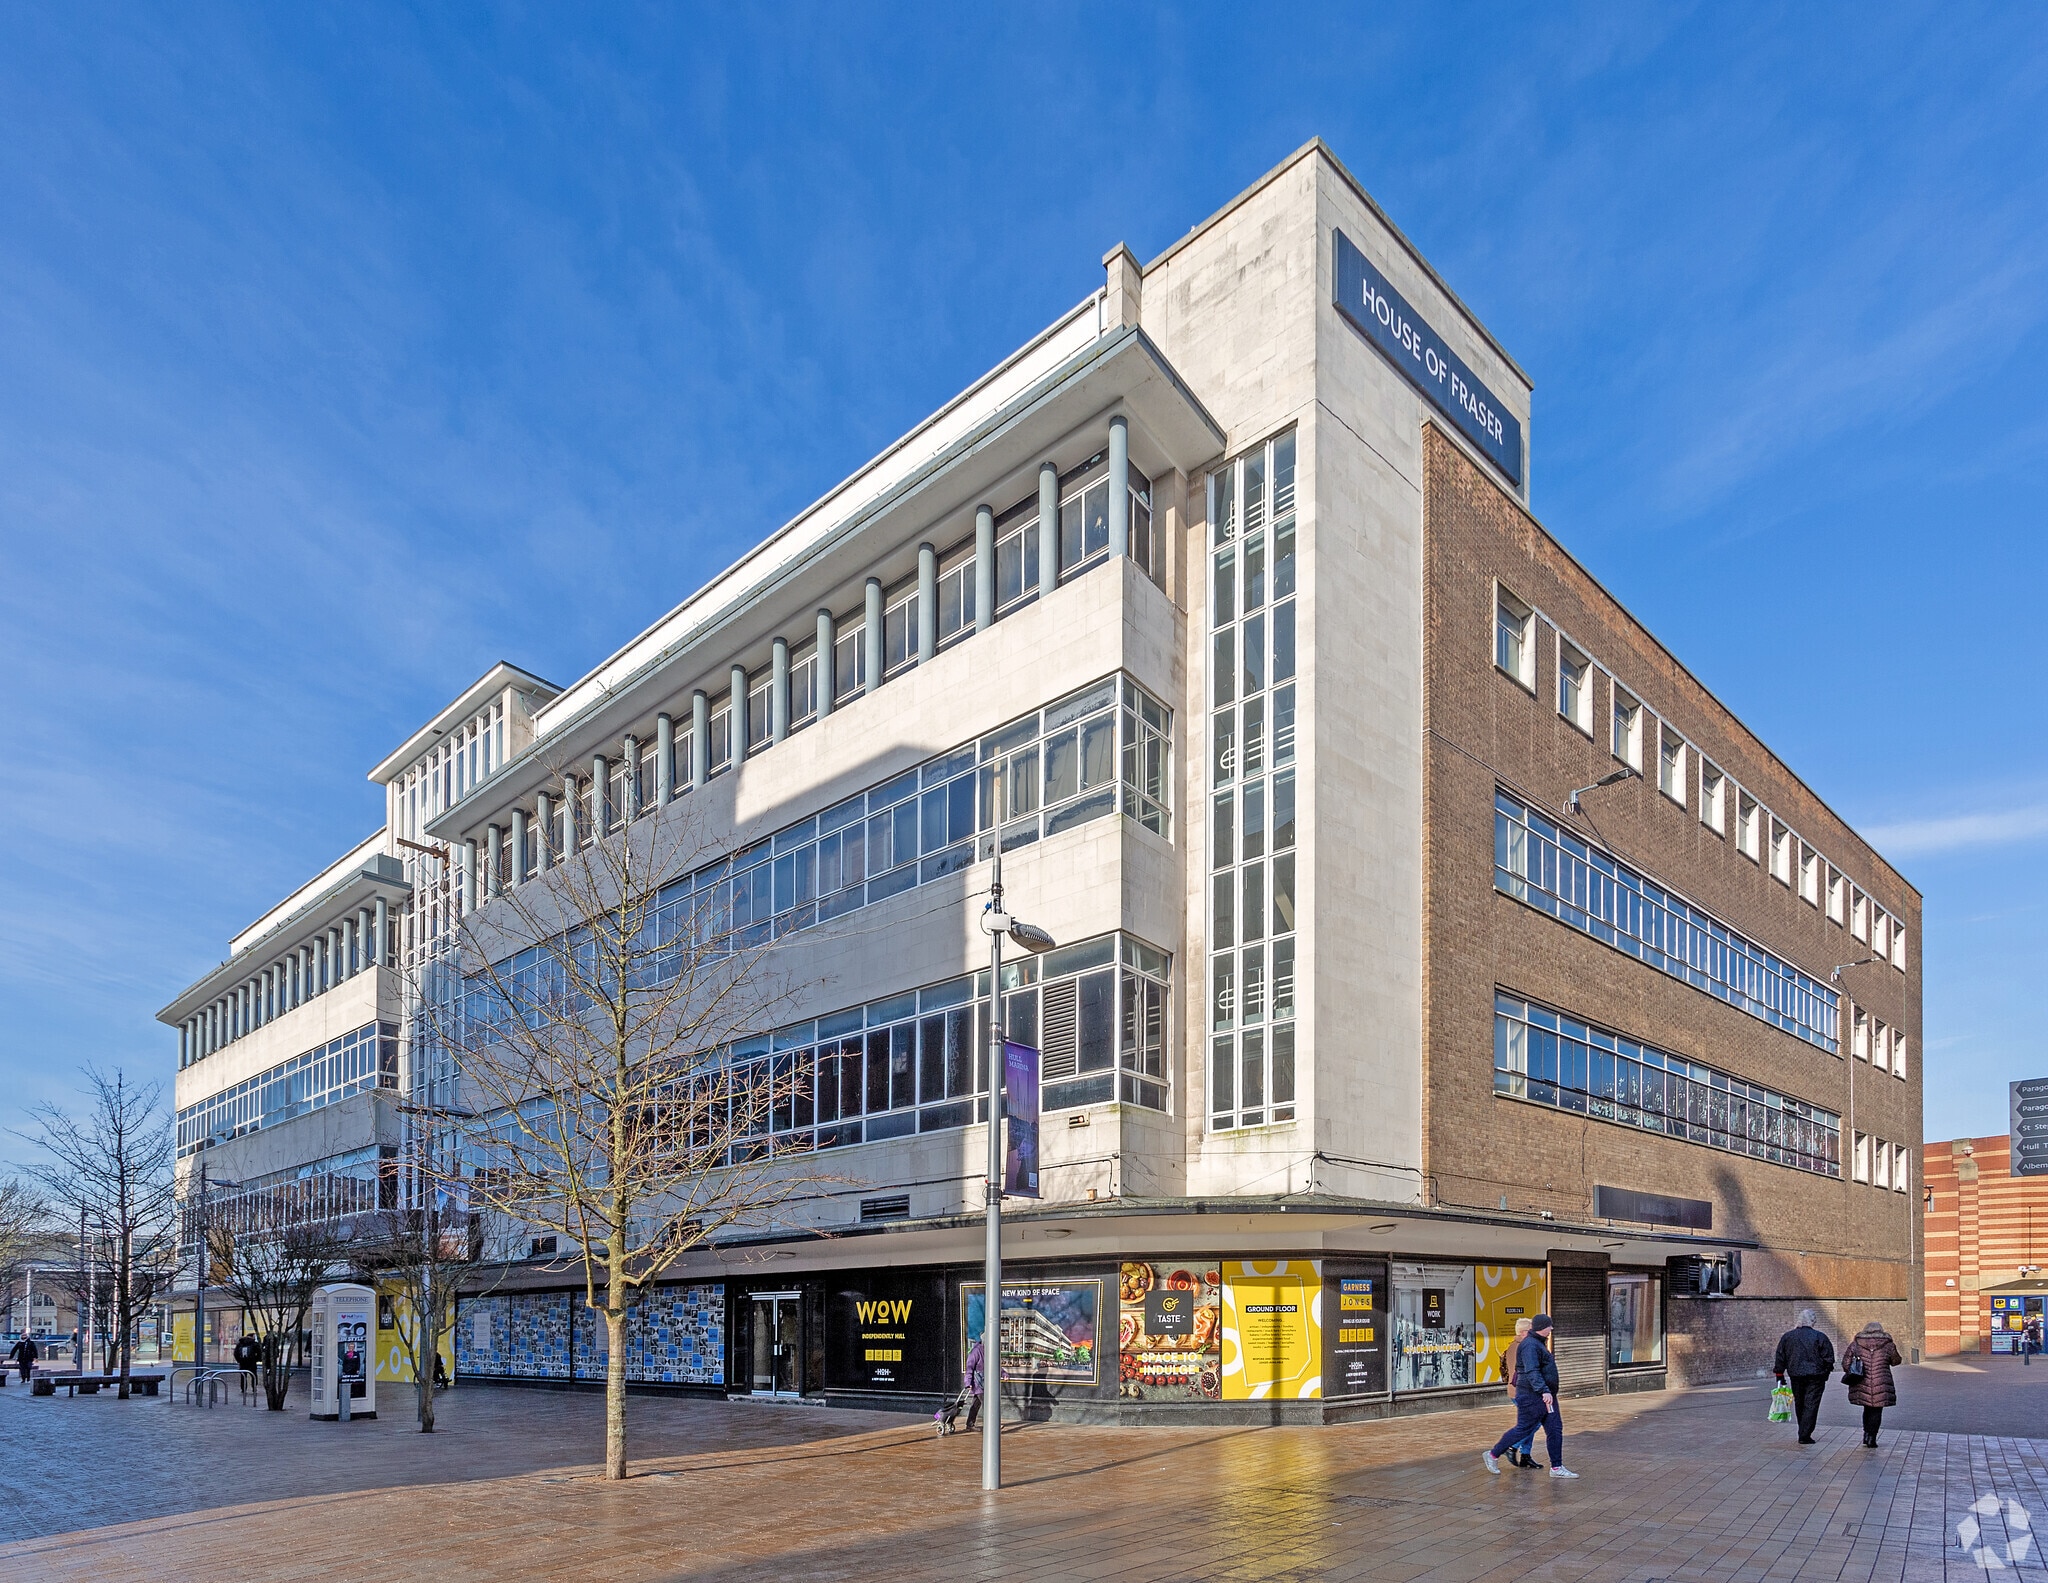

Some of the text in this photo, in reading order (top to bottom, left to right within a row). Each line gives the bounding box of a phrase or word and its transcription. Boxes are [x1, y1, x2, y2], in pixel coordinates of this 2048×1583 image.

[1362, 278, 1503, 445] HOUSE OF FRASER
[1008, 1053, 1022, 1063] HULL
[1343, 1283, 1370, 1292] GARNESS
[1002, 1289, 1016, 1297] NEW
[1041, 1288, 1060, 1296] SPACE
[1343, 1298, 1370, 1306] JONES
[856, 1300, 912, 1325] WOW
[1427, 1310, 1441, 1318] WORK
[1157, 1314, 1181, 1323] TASTE
[1141, 1351, 1198, 1363] SPACE TO
[1143, 1365, 1196, 1376] INDULGE
